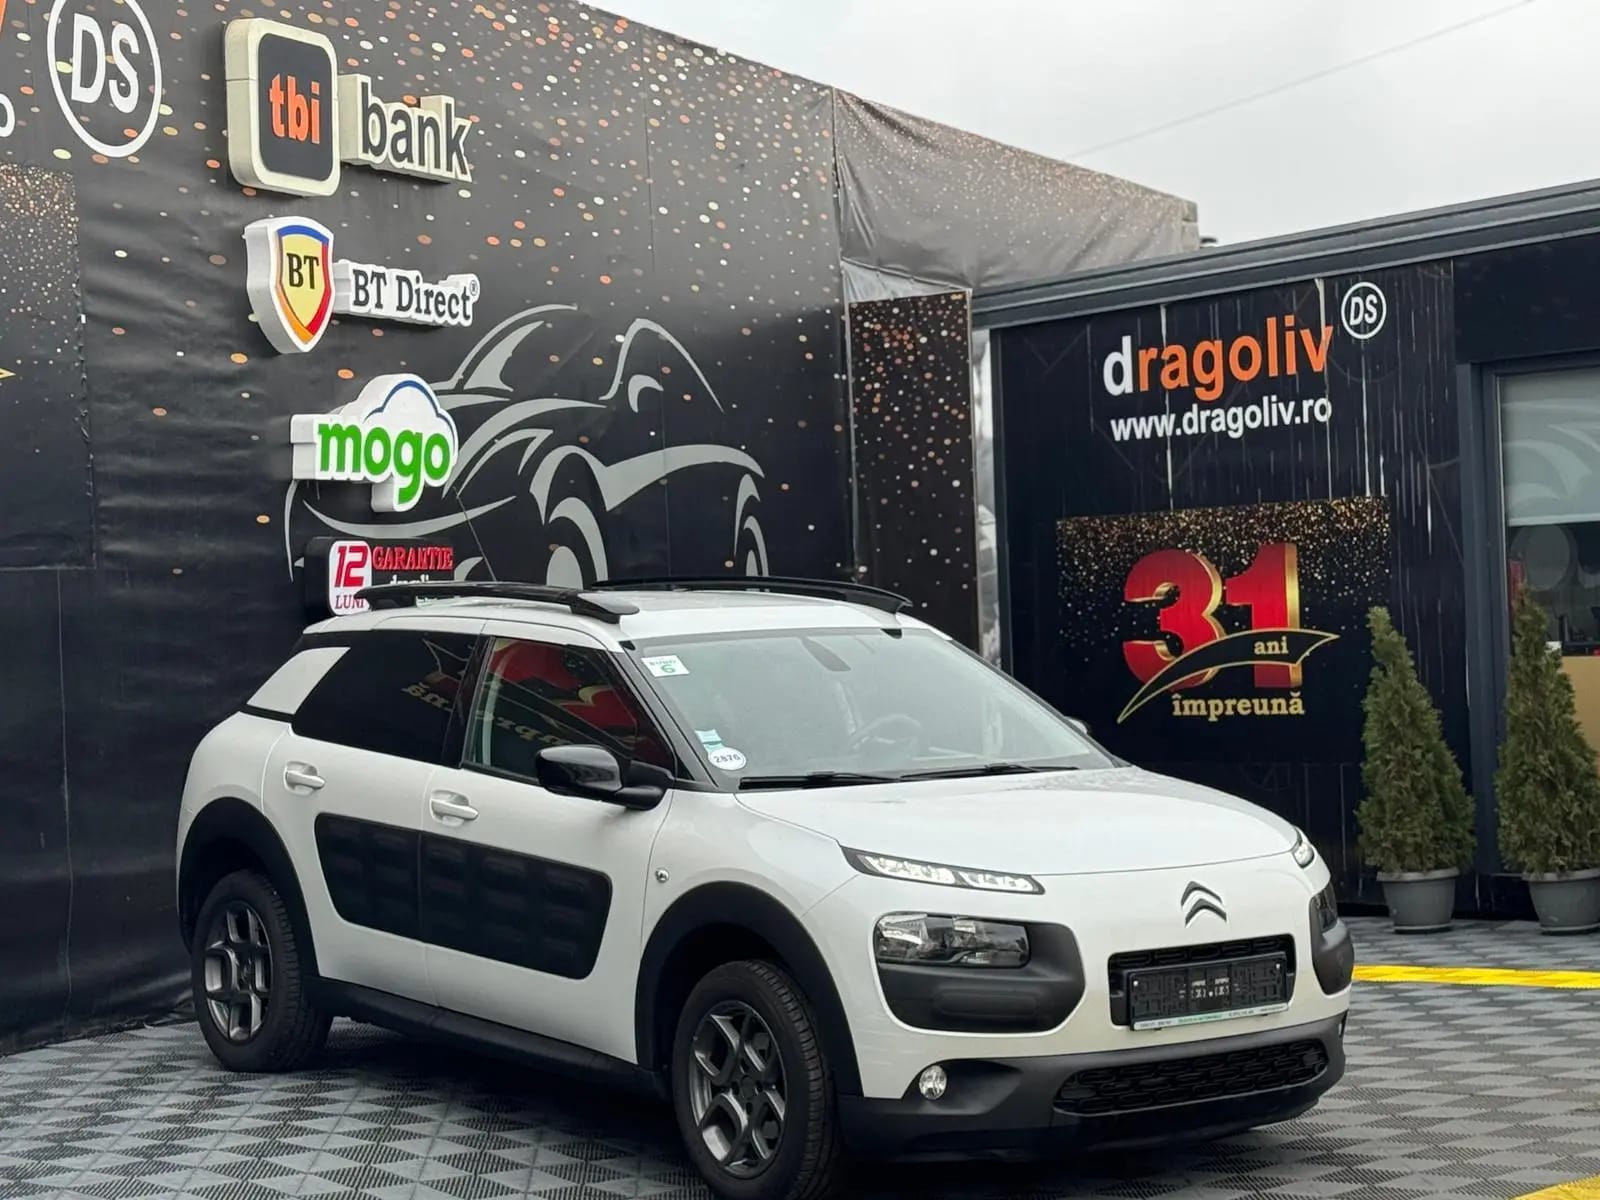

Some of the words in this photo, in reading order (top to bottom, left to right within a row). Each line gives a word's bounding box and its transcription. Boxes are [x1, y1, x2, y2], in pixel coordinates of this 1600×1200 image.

[71, 13, 140, 113] DS
[269, 73, 320, 144] tbi
[360, 81, 468, 175] bank
[286, 253, 319, 289] BT
[353, 269, 387, 309] BT
[1350, 295, 1378, 326] DS
[1103, 315, 1333, 401] dragoliv
[1110, 395, 1332, 441] www.dragoliv.ro
[318, 423, 451, 505] mogo
[334, 546, 368, 587] 12
[372, 546, 453, 571] GARANTIE
[1122, 542, 1303, 692] 31
[1254, 636, 1289, 655] ani
[660, 664, 676, 674] 6
[1171, 691, 1305, 722] împreună
